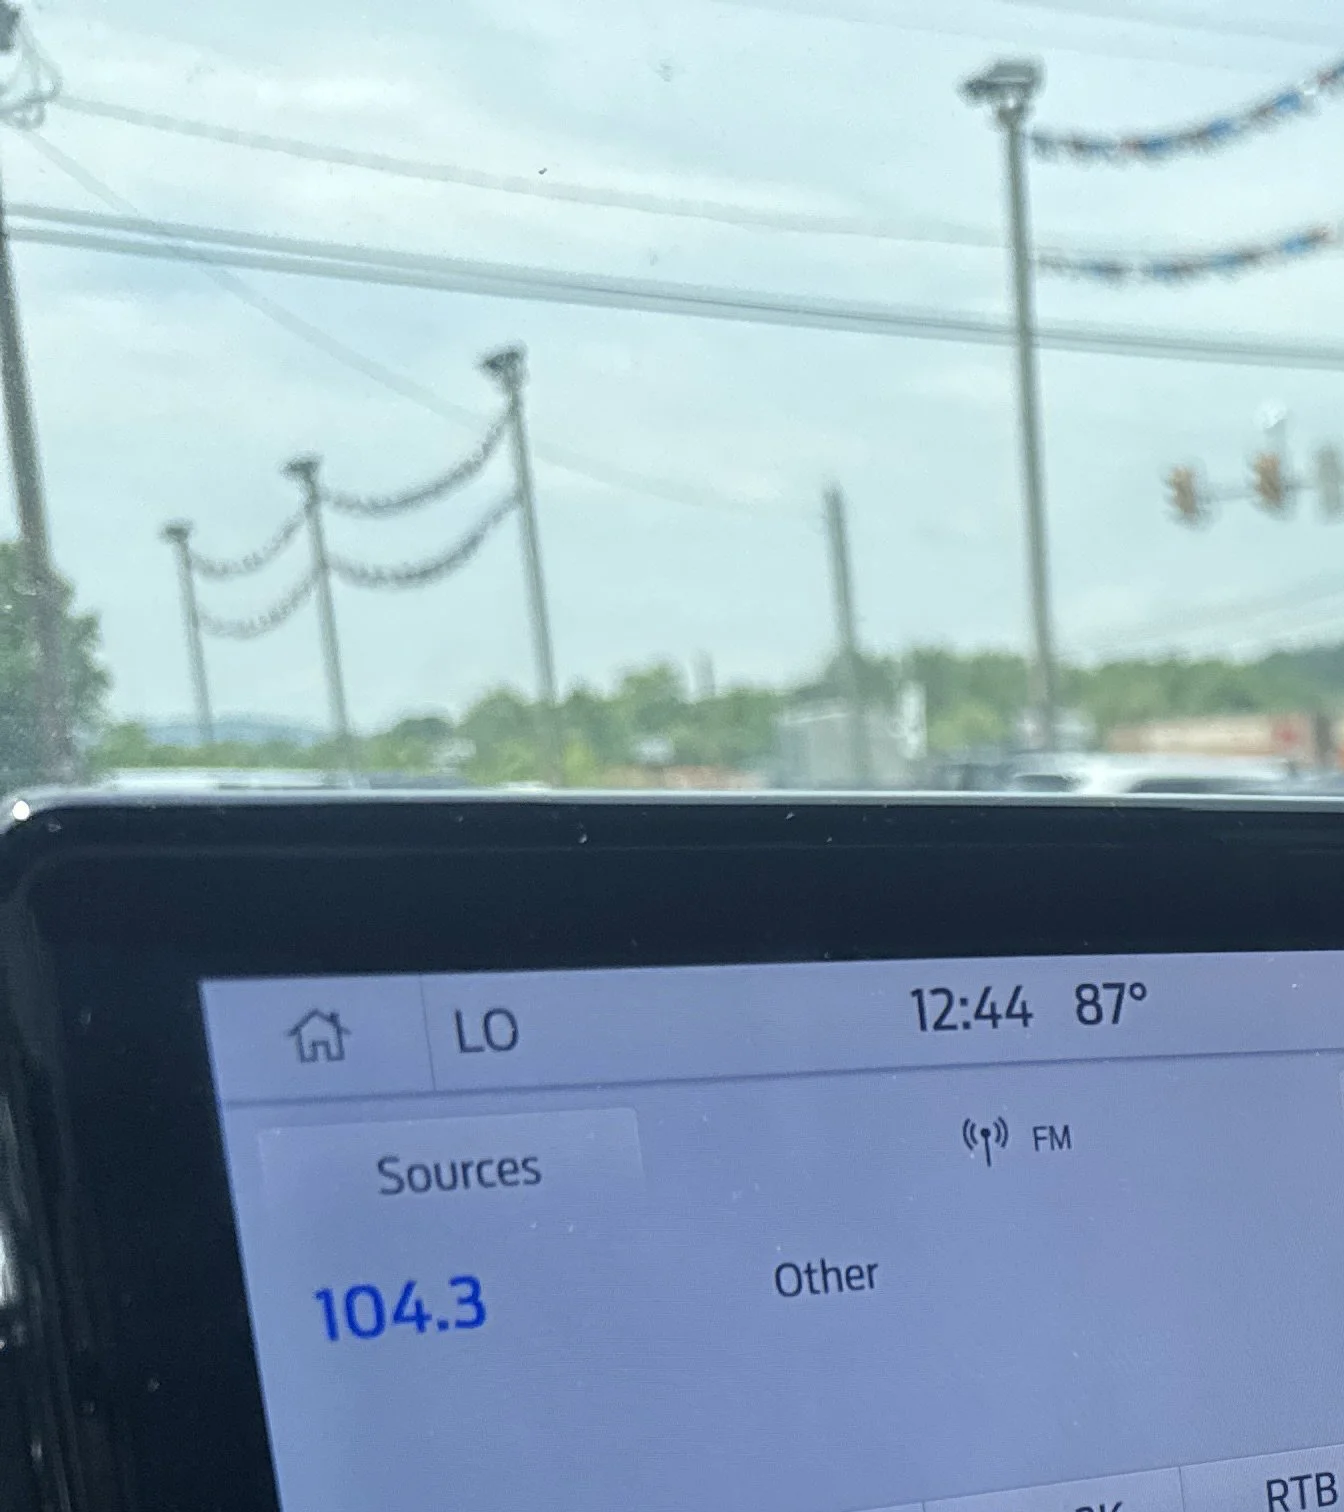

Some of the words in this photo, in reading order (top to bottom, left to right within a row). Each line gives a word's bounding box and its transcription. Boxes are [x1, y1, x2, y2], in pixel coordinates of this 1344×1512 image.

[454, 1007, 520, 1055] LO
[909, 984, 1034, 1032] 12:44
[1032, 1125, 1072, 1153] FM
[376, 1151, 543, 1196] Sources
[773, 1256, 880, 1298] Other
[314, 1274, 488, 1343] 104.3
